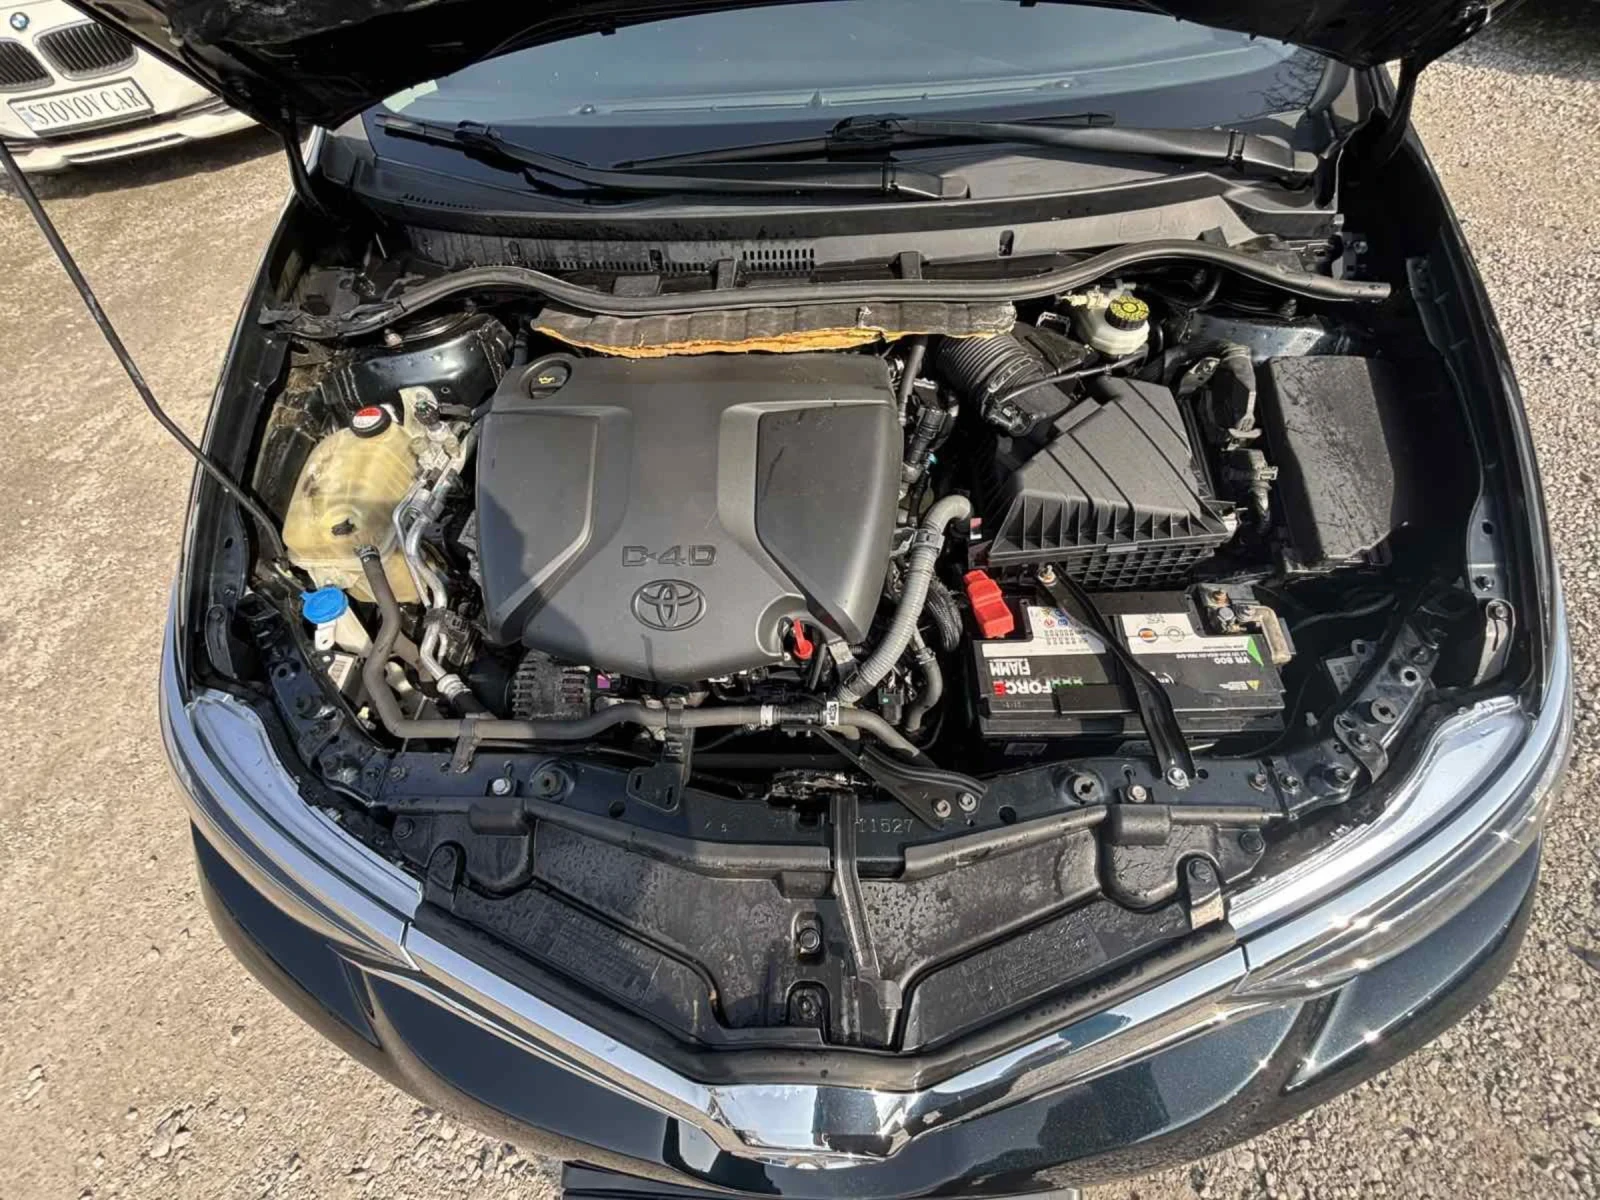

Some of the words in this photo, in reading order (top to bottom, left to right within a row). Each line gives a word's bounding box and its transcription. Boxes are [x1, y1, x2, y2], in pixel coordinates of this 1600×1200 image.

[28, 94, 103, 125] STOYOV
[100, 87, 144, 112] CAR
[989, 658, 1031, 677] FIAMM
